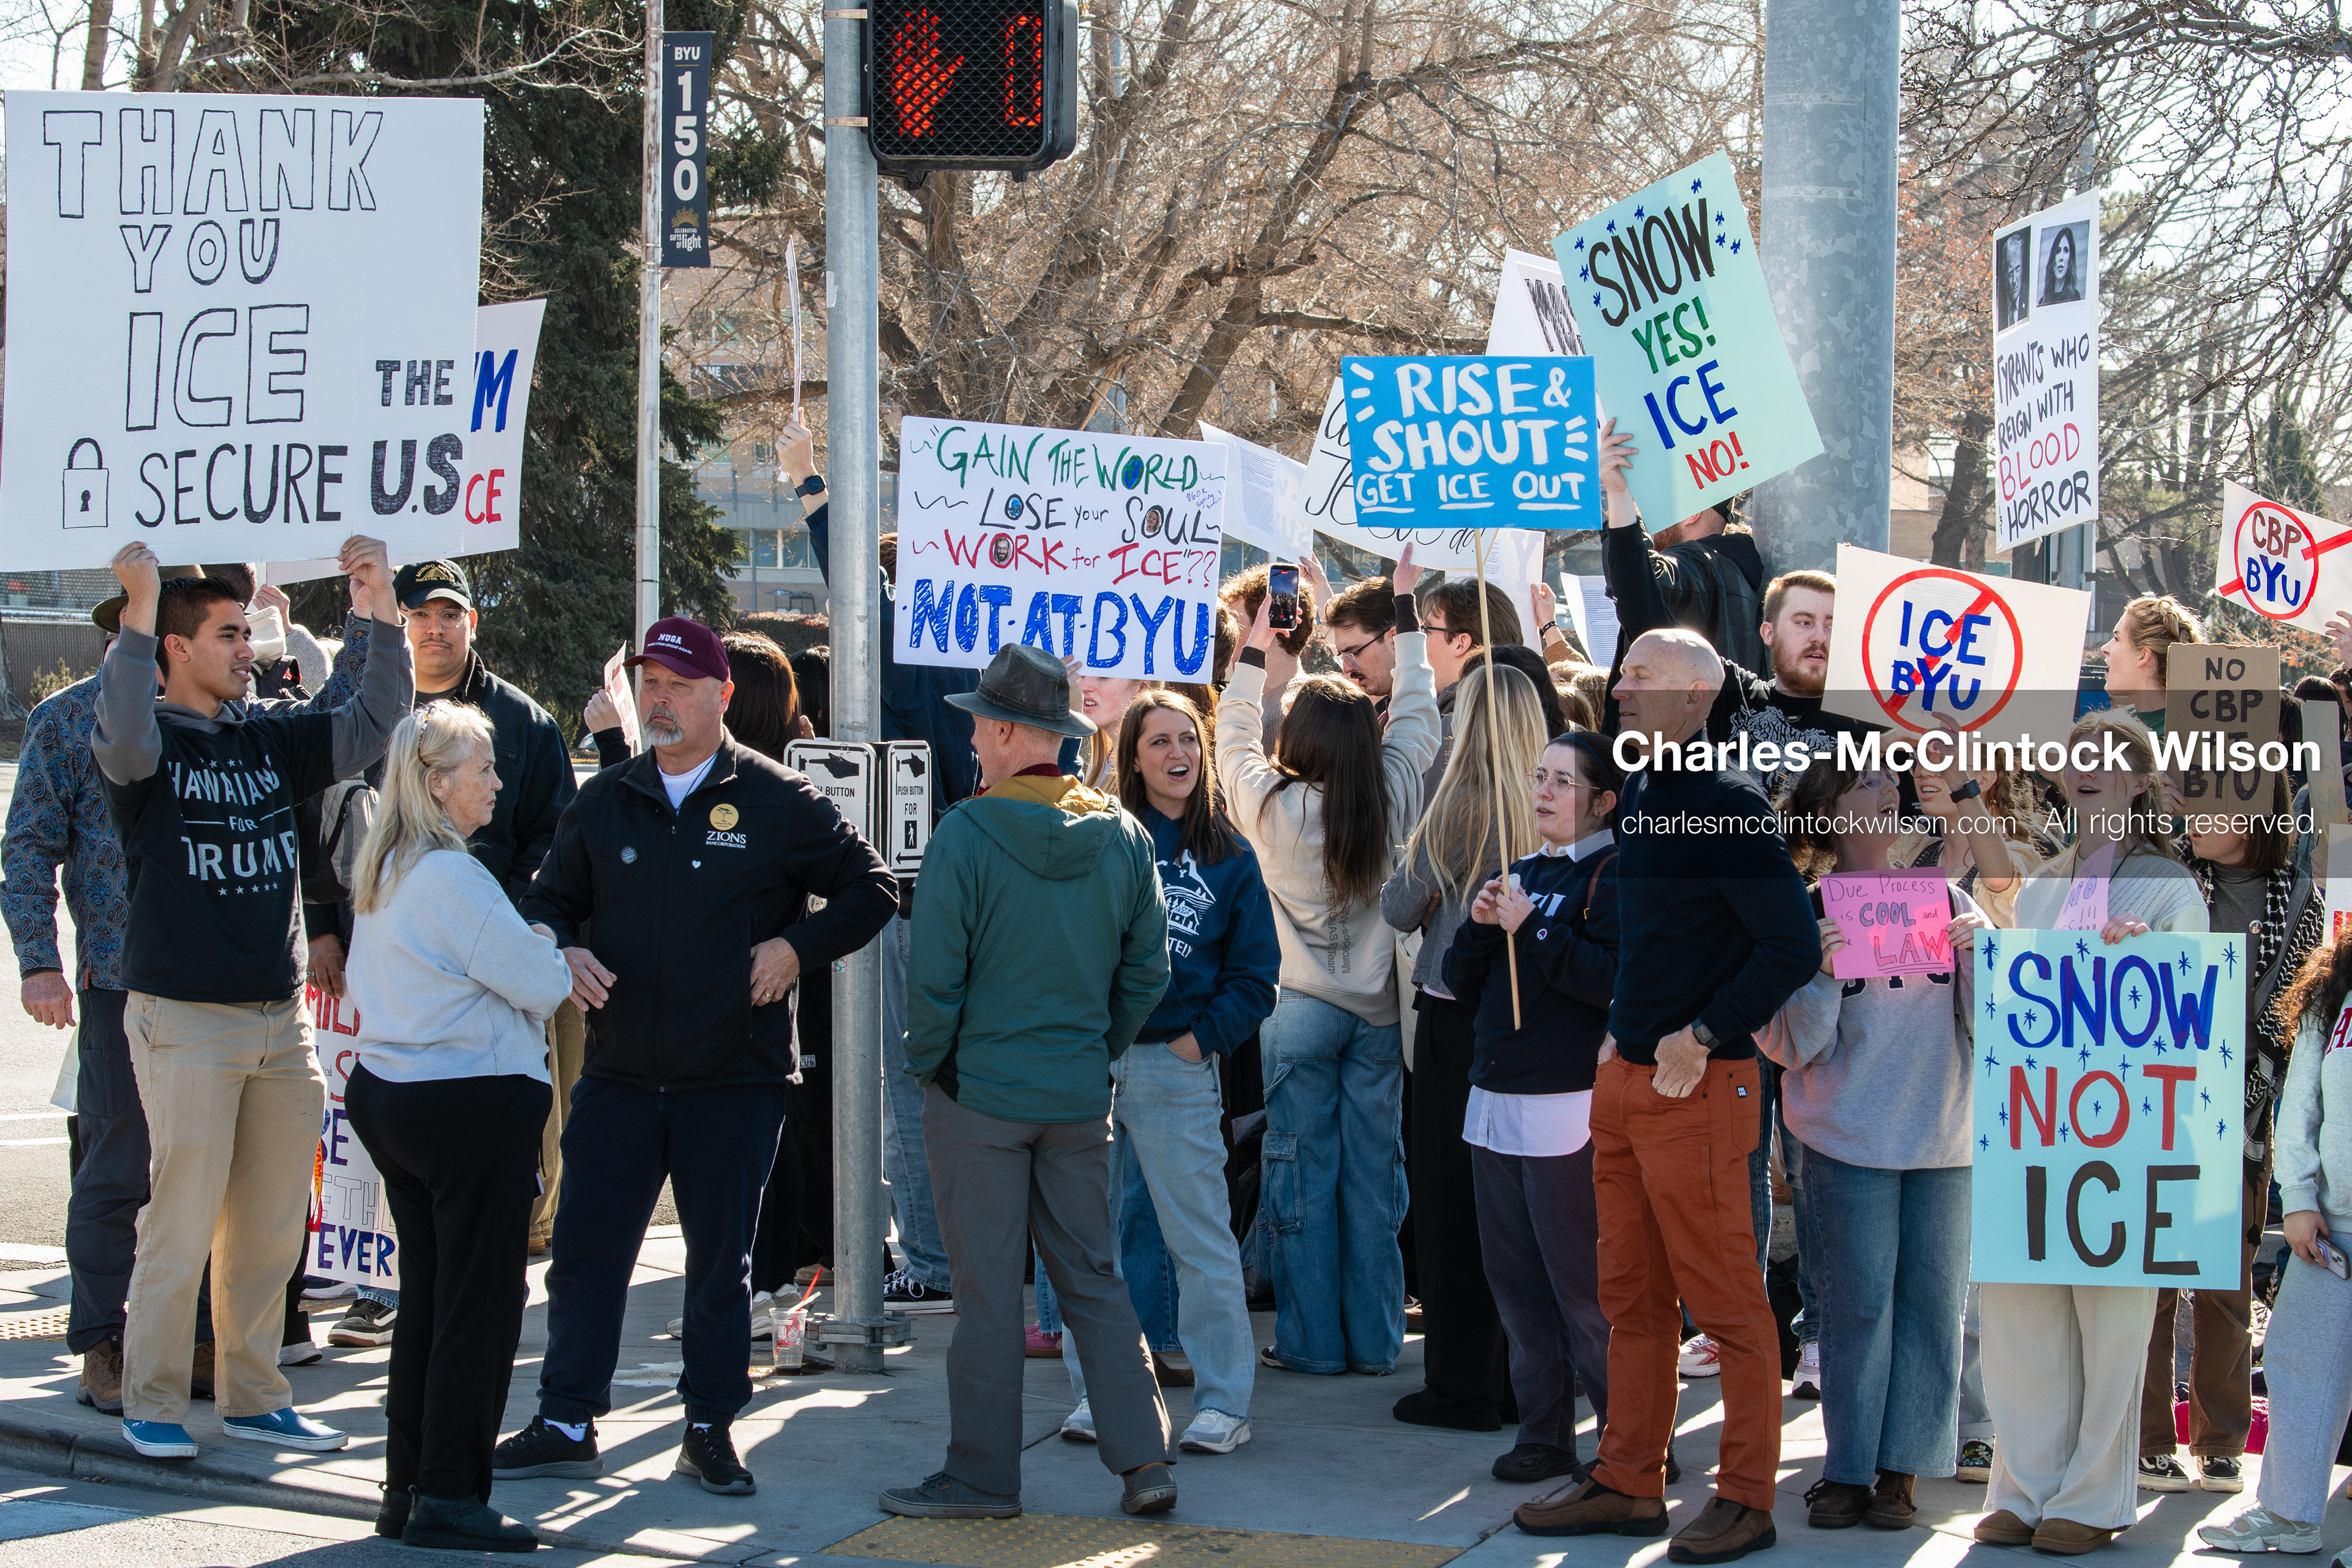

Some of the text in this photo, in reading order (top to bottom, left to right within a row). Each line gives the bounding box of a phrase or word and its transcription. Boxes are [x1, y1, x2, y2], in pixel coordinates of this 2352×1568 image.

[674, 47, 700, 60] BYU
[43, 108, 383, 219] THANK
[119, 218, 280, 293] YOU
[682, 233, 701, 251] light
[1589, 197, 1716, 327] SNOW
[1632, 296, 1716, 374] YES!
[126, 304, 309, 432] ICE
[375, 359, 455, 407] THE
[1395, 363, 1572, 418] RISE &
[1997, 333, 2089, 407] TYRANTS WHO
[1643, 359, 1738, 450] ICE
[1998, 379, 2074, 454] REIGN WITH
[1048, 439, 1089, 488] THE
[1092, 443, 1198, 495] WORLD
[1366, 419, 1559, 473] SHOUT
[1686, 431, 1751, 490] NO!
[1999, 423, 2080, 502] BLOOD
[135, 433, 464, 529] SECURE U.S
[1355, 472, 1585, 510] GET ICE OUT
[2007, 470, 2092, 541] HORROR
[979, 488, 1219, 545] LOSE your SOUL
[2252, 510, 2302, 559] CBP
[416, 564, 435, 577] MUNDO
[944, 529, 1068, 575] WORK
[1072, 547, 1101, 570] for
[2246, 554, 2301, 606] BYU
[658, 633, 682, 644] MUGA
[679, 646, 693, 655] AGAIN
[910, 579, 1210, 676] NOT AT BYU
[1900, 600, 1992, 666] ICE
[1891, 657, 1981, 712] BYU
[2206, 657, 2245, 681] NO
[2190, 689, 2264, 723] CBP
[825, 786, 855, 797] BUTTON
[898, 786, 924, 795] PUSH BUTTON
[2184, 763, 2261, 801] BYU
[229, 816, 258, 832] FOR
[905, 803, 917, 815] FOR
[181, 830, 295, 881] TRUMP
[706, 831, 747, 844] ZIONS
[706, 840, 746, 849] BANCORPORATION
[1827, 874, 1935, 902] Due Process
[1841, 902, 1939, 927] is COOL and
[2008, 951, 2218, 1051] SNOW
[2008, 1063, 2198, 1152] NOT
[2025, 1159, 2201, 1276] ICE
